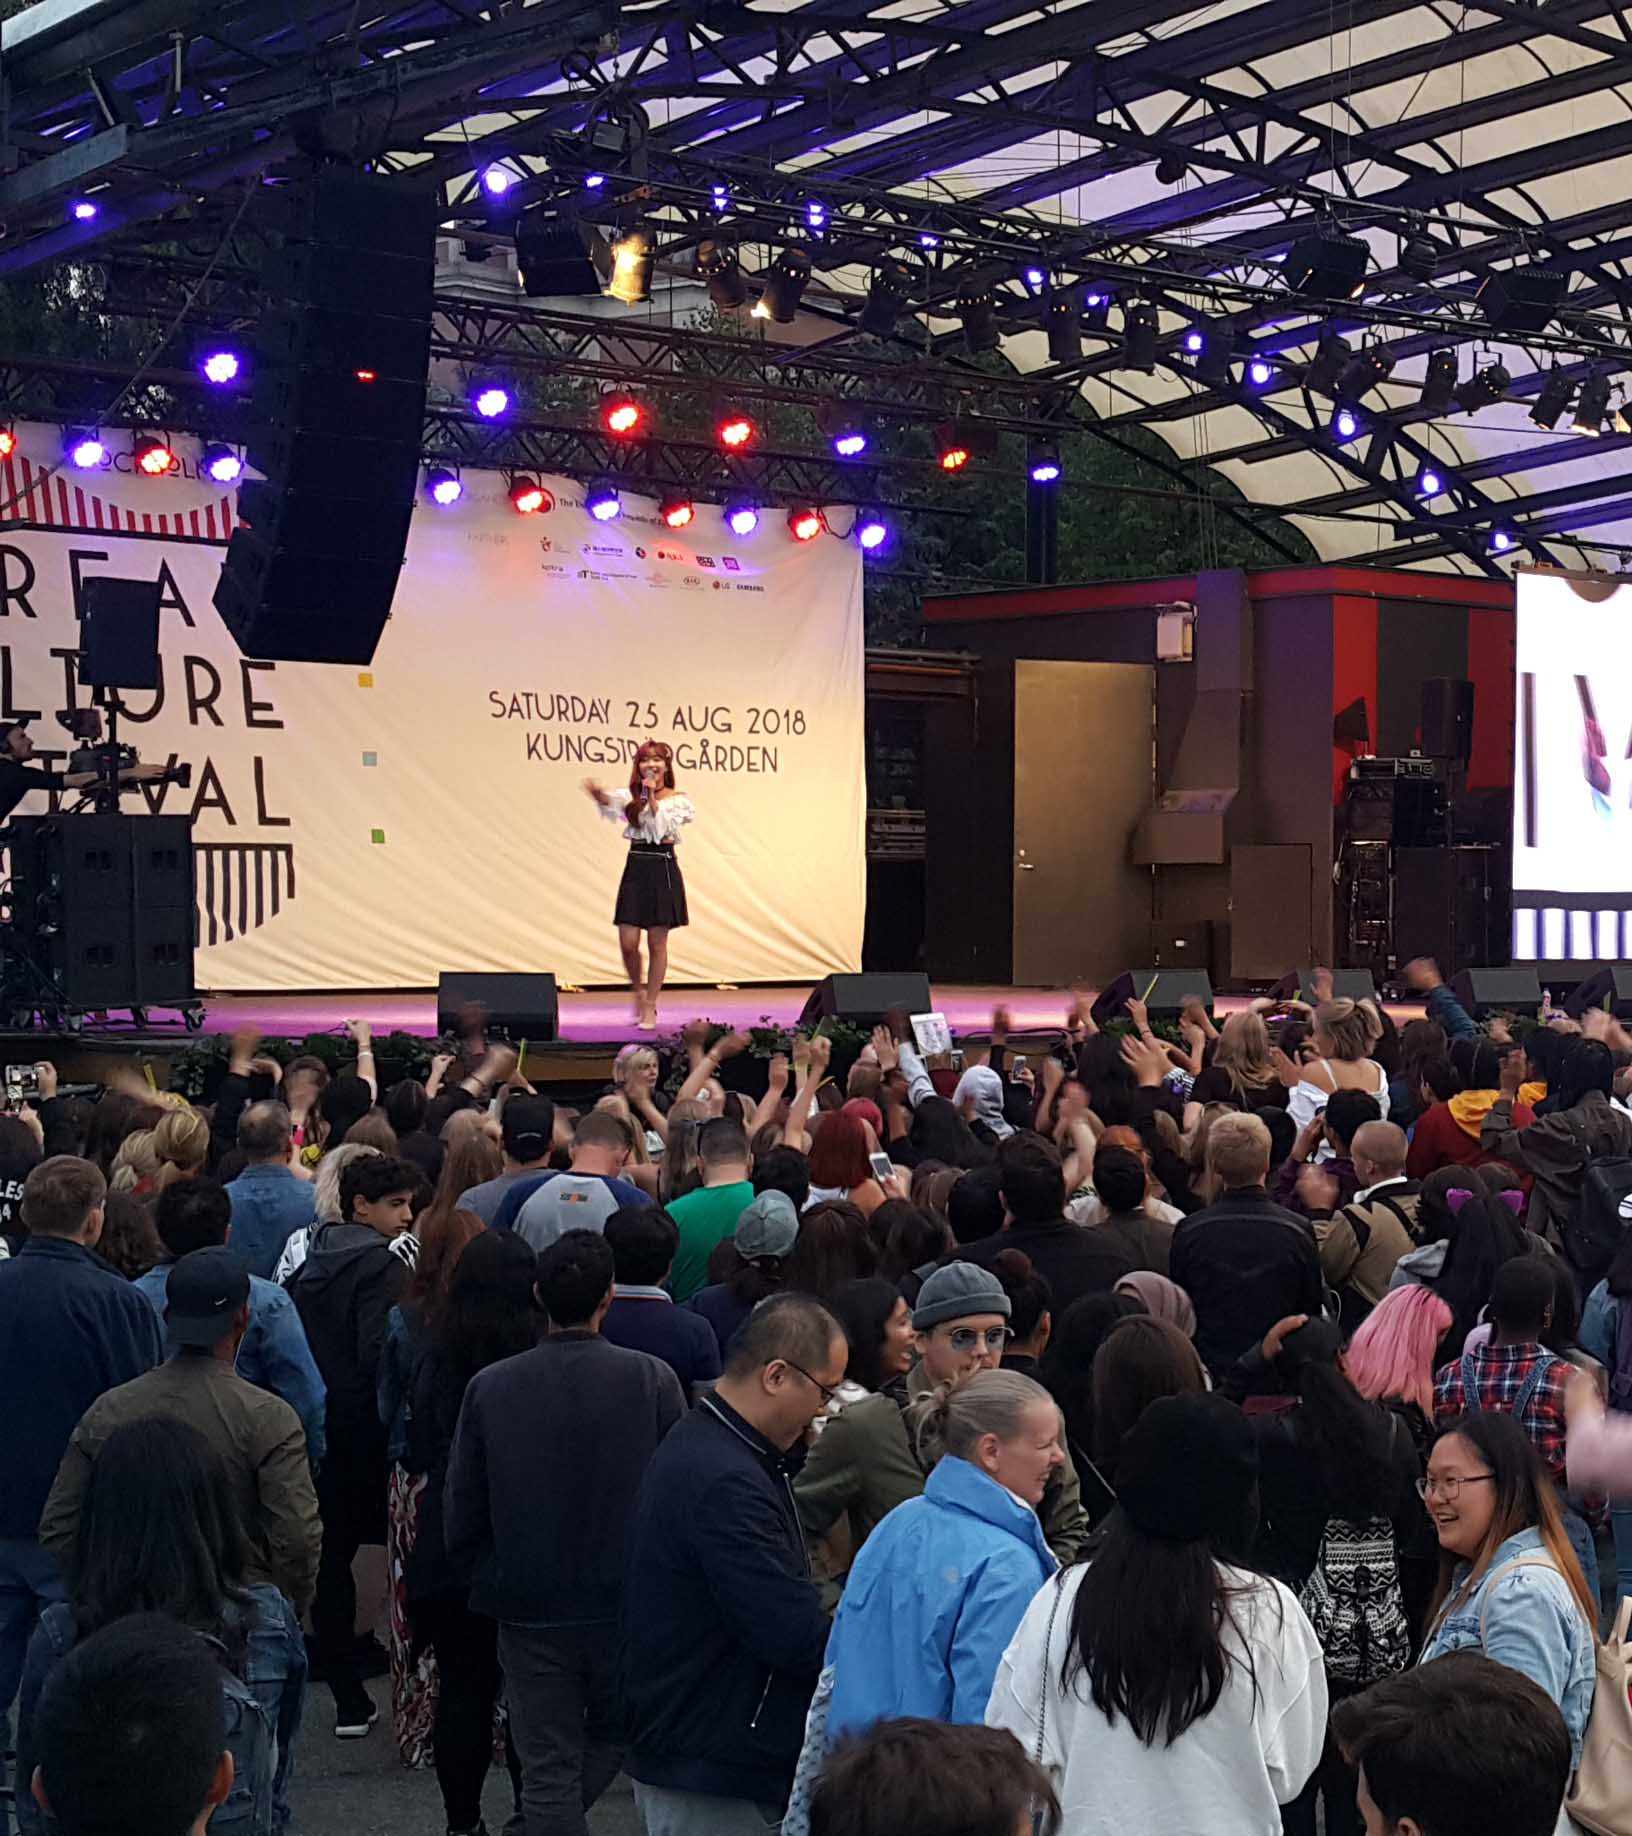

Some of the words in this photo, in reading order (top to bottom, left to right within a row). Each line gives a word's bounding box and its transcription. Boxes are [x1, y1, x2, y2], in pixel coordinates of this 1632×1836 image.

[488, 690, 611, 725] SATURDAY
[626, 701, 659, 729] 25
[672, 705, 733, 733] AUG
[746, 708, 807, 735] 2018
